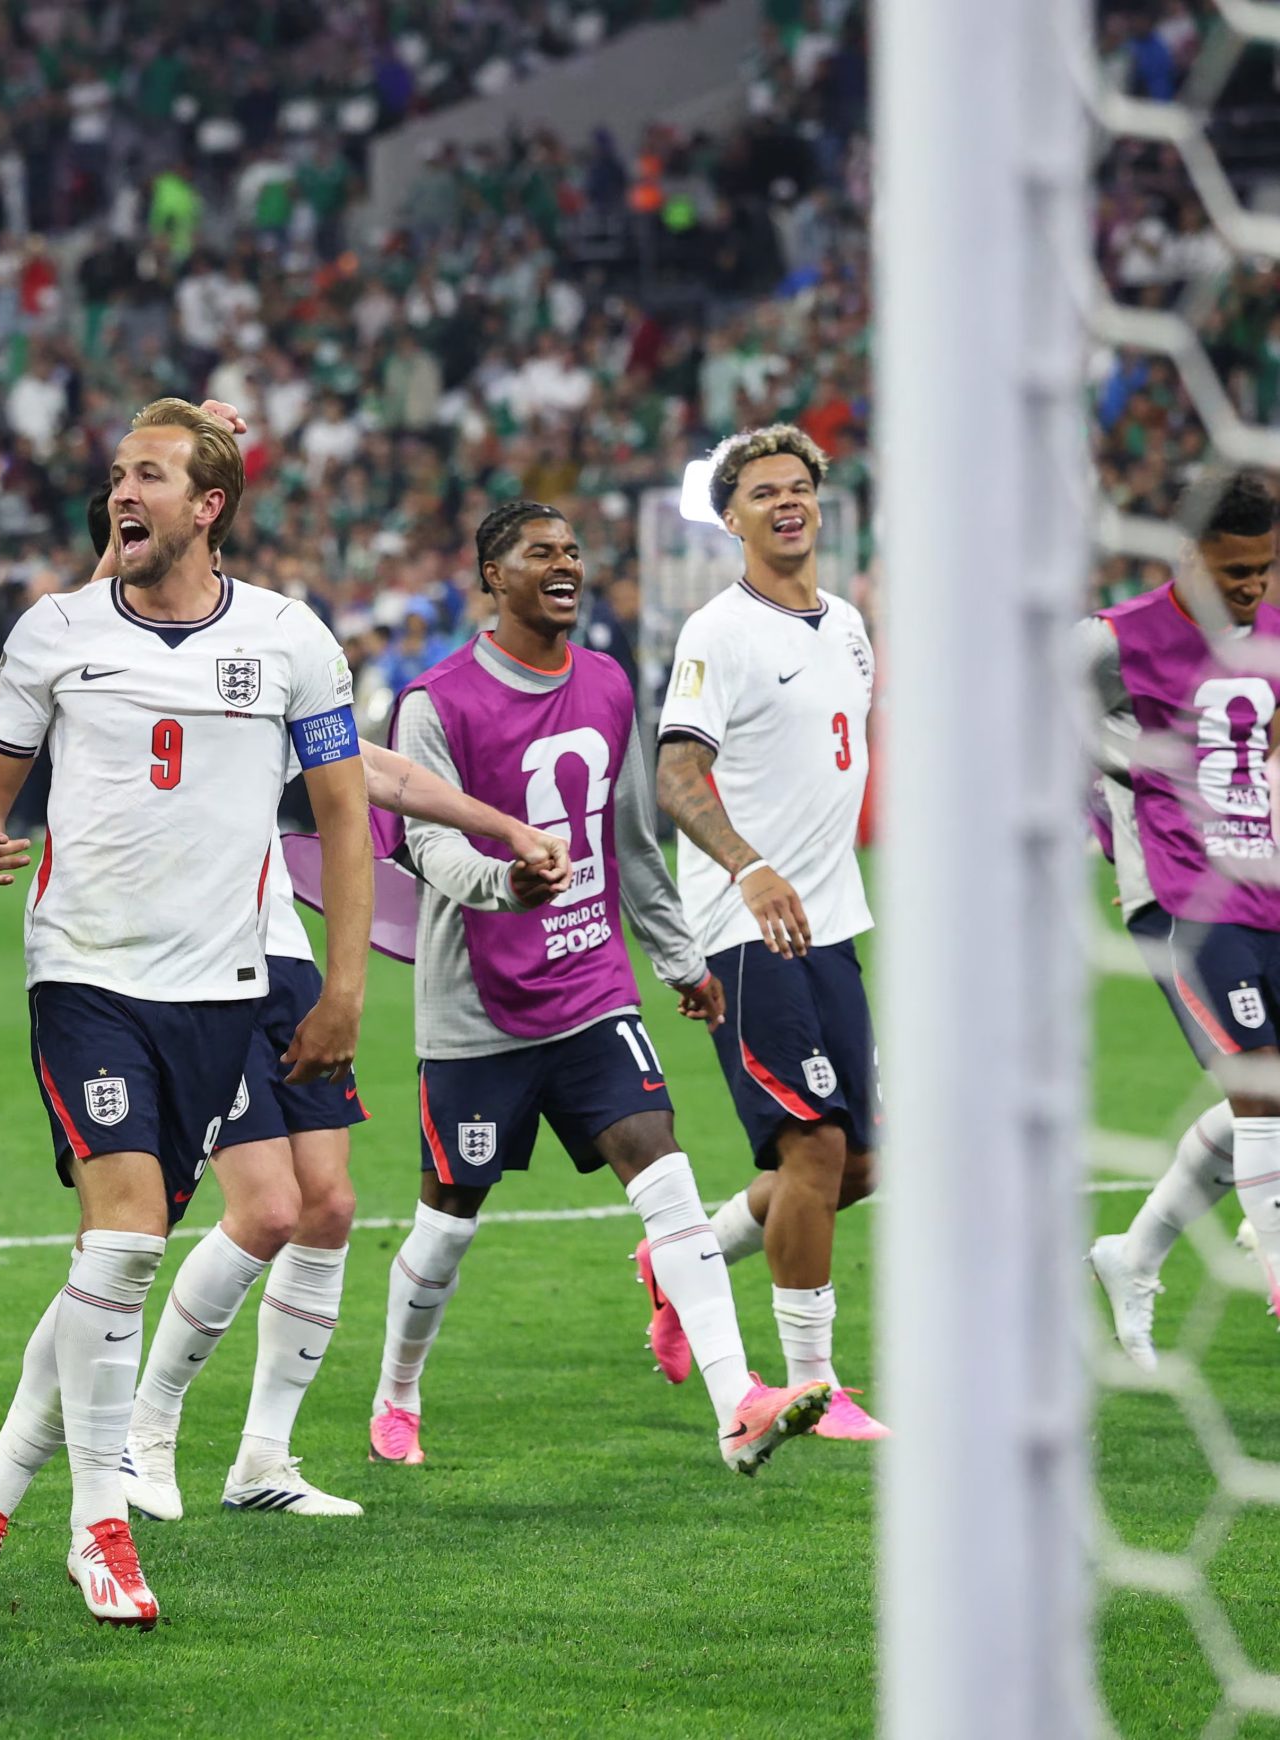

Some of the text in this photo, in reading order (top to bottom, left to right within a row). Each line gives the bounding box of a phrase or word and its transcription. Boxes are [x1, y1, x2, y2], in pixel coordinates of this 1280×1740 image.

[303, 713, 343, 731] FOOTBALL
[305, 722, 347, 744] UNITES
[832, 712, 851, 771] 3
[150, 719, 184, 790] 9
[306, 734, 350, 756] the World
[541, 907, 590, 933] WORLD
[545, 917, 612, 960] 2026
[616, 1021, 663, 1075] 11
[194, 1115, 222, 1181] 9
